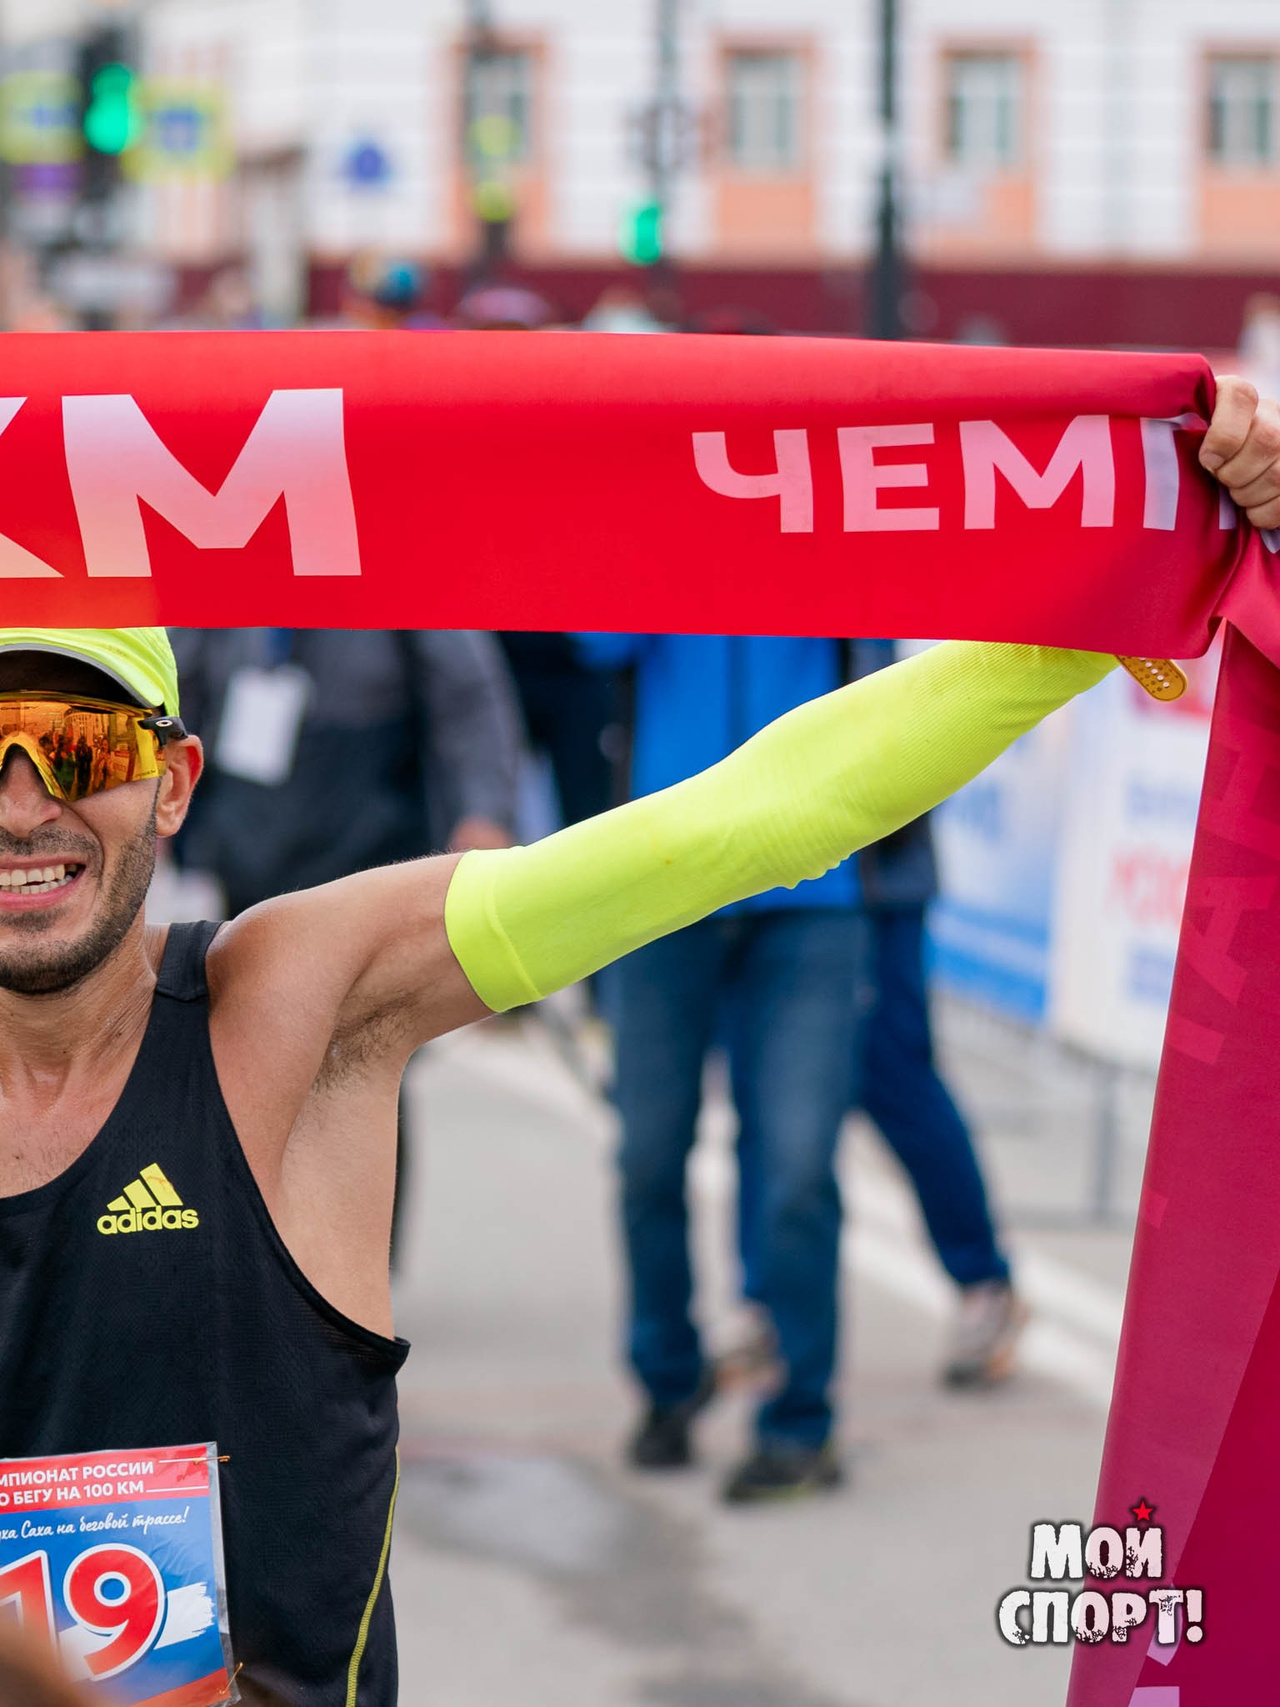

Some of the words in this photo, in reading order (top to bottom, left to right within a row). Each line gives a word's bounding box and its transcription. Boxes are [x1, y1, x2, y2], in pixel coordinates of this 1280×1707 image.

[97, 1204, 200, 1235] adidas
[82, 1460, 154, 1480] РОССИИ
[13, 1488, 54, 1505] БЕГУ
[56, 1485, 81, 1501] НА
[84, 1482, 114, 1498] 100
[116, 1480, 145, 1495] КМ
[21, 1519, 54, 1539] Саха
[56, 1523, 76, 1534] на
[79, 1511, 129, 1533] беговой
[132, 1505, 190, 1535] трассе!
